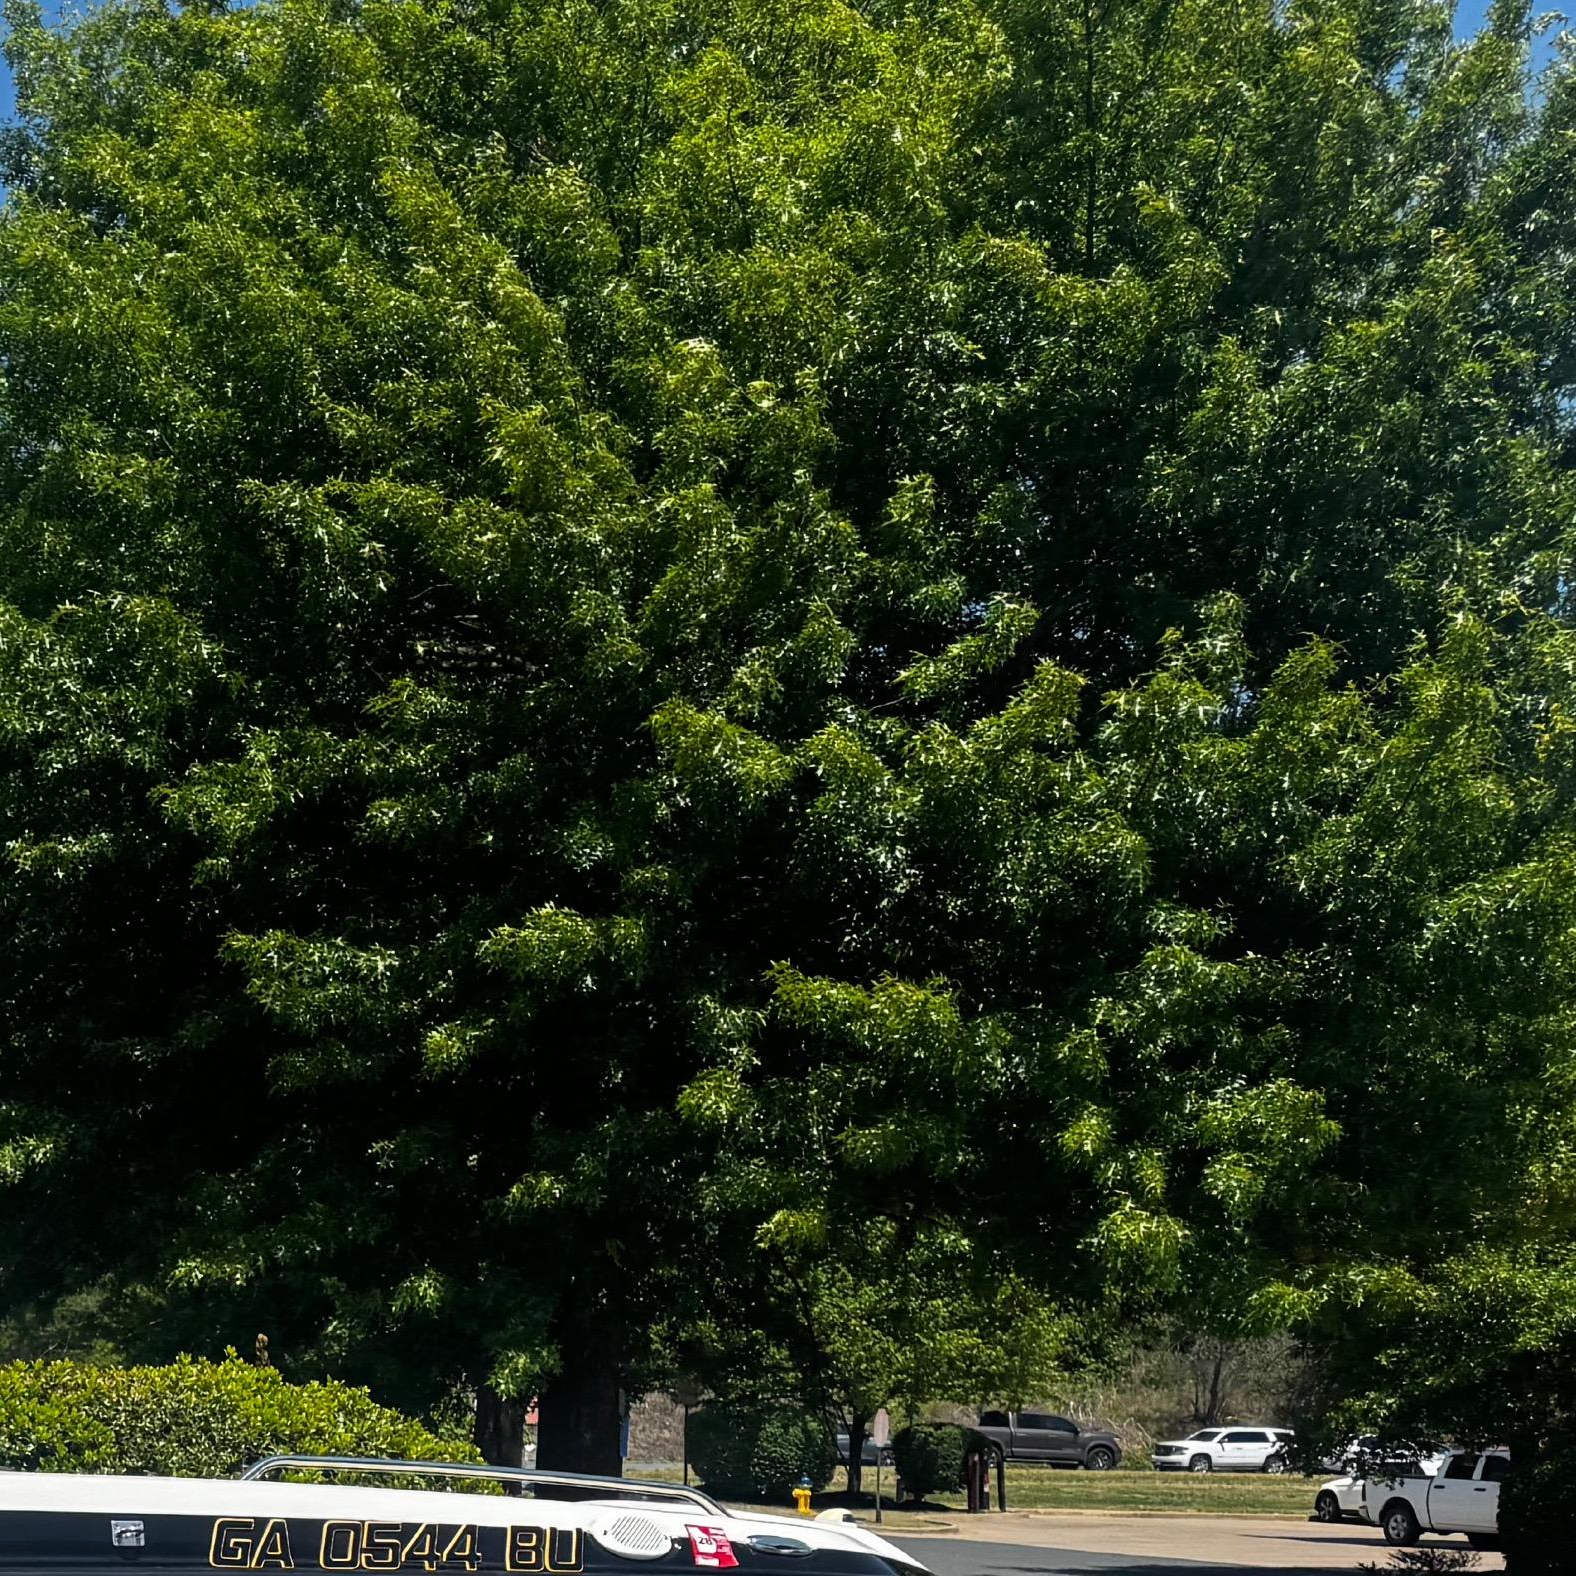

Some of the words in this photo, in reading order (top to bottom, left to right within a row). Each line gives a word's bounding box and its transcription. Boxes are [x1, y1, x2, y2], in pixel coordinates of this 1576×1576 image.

[208, 1517, 295, 1569] GA
[319, 1519, 482, 1572] 0544
[505, 1524, 585, 1574] BU
